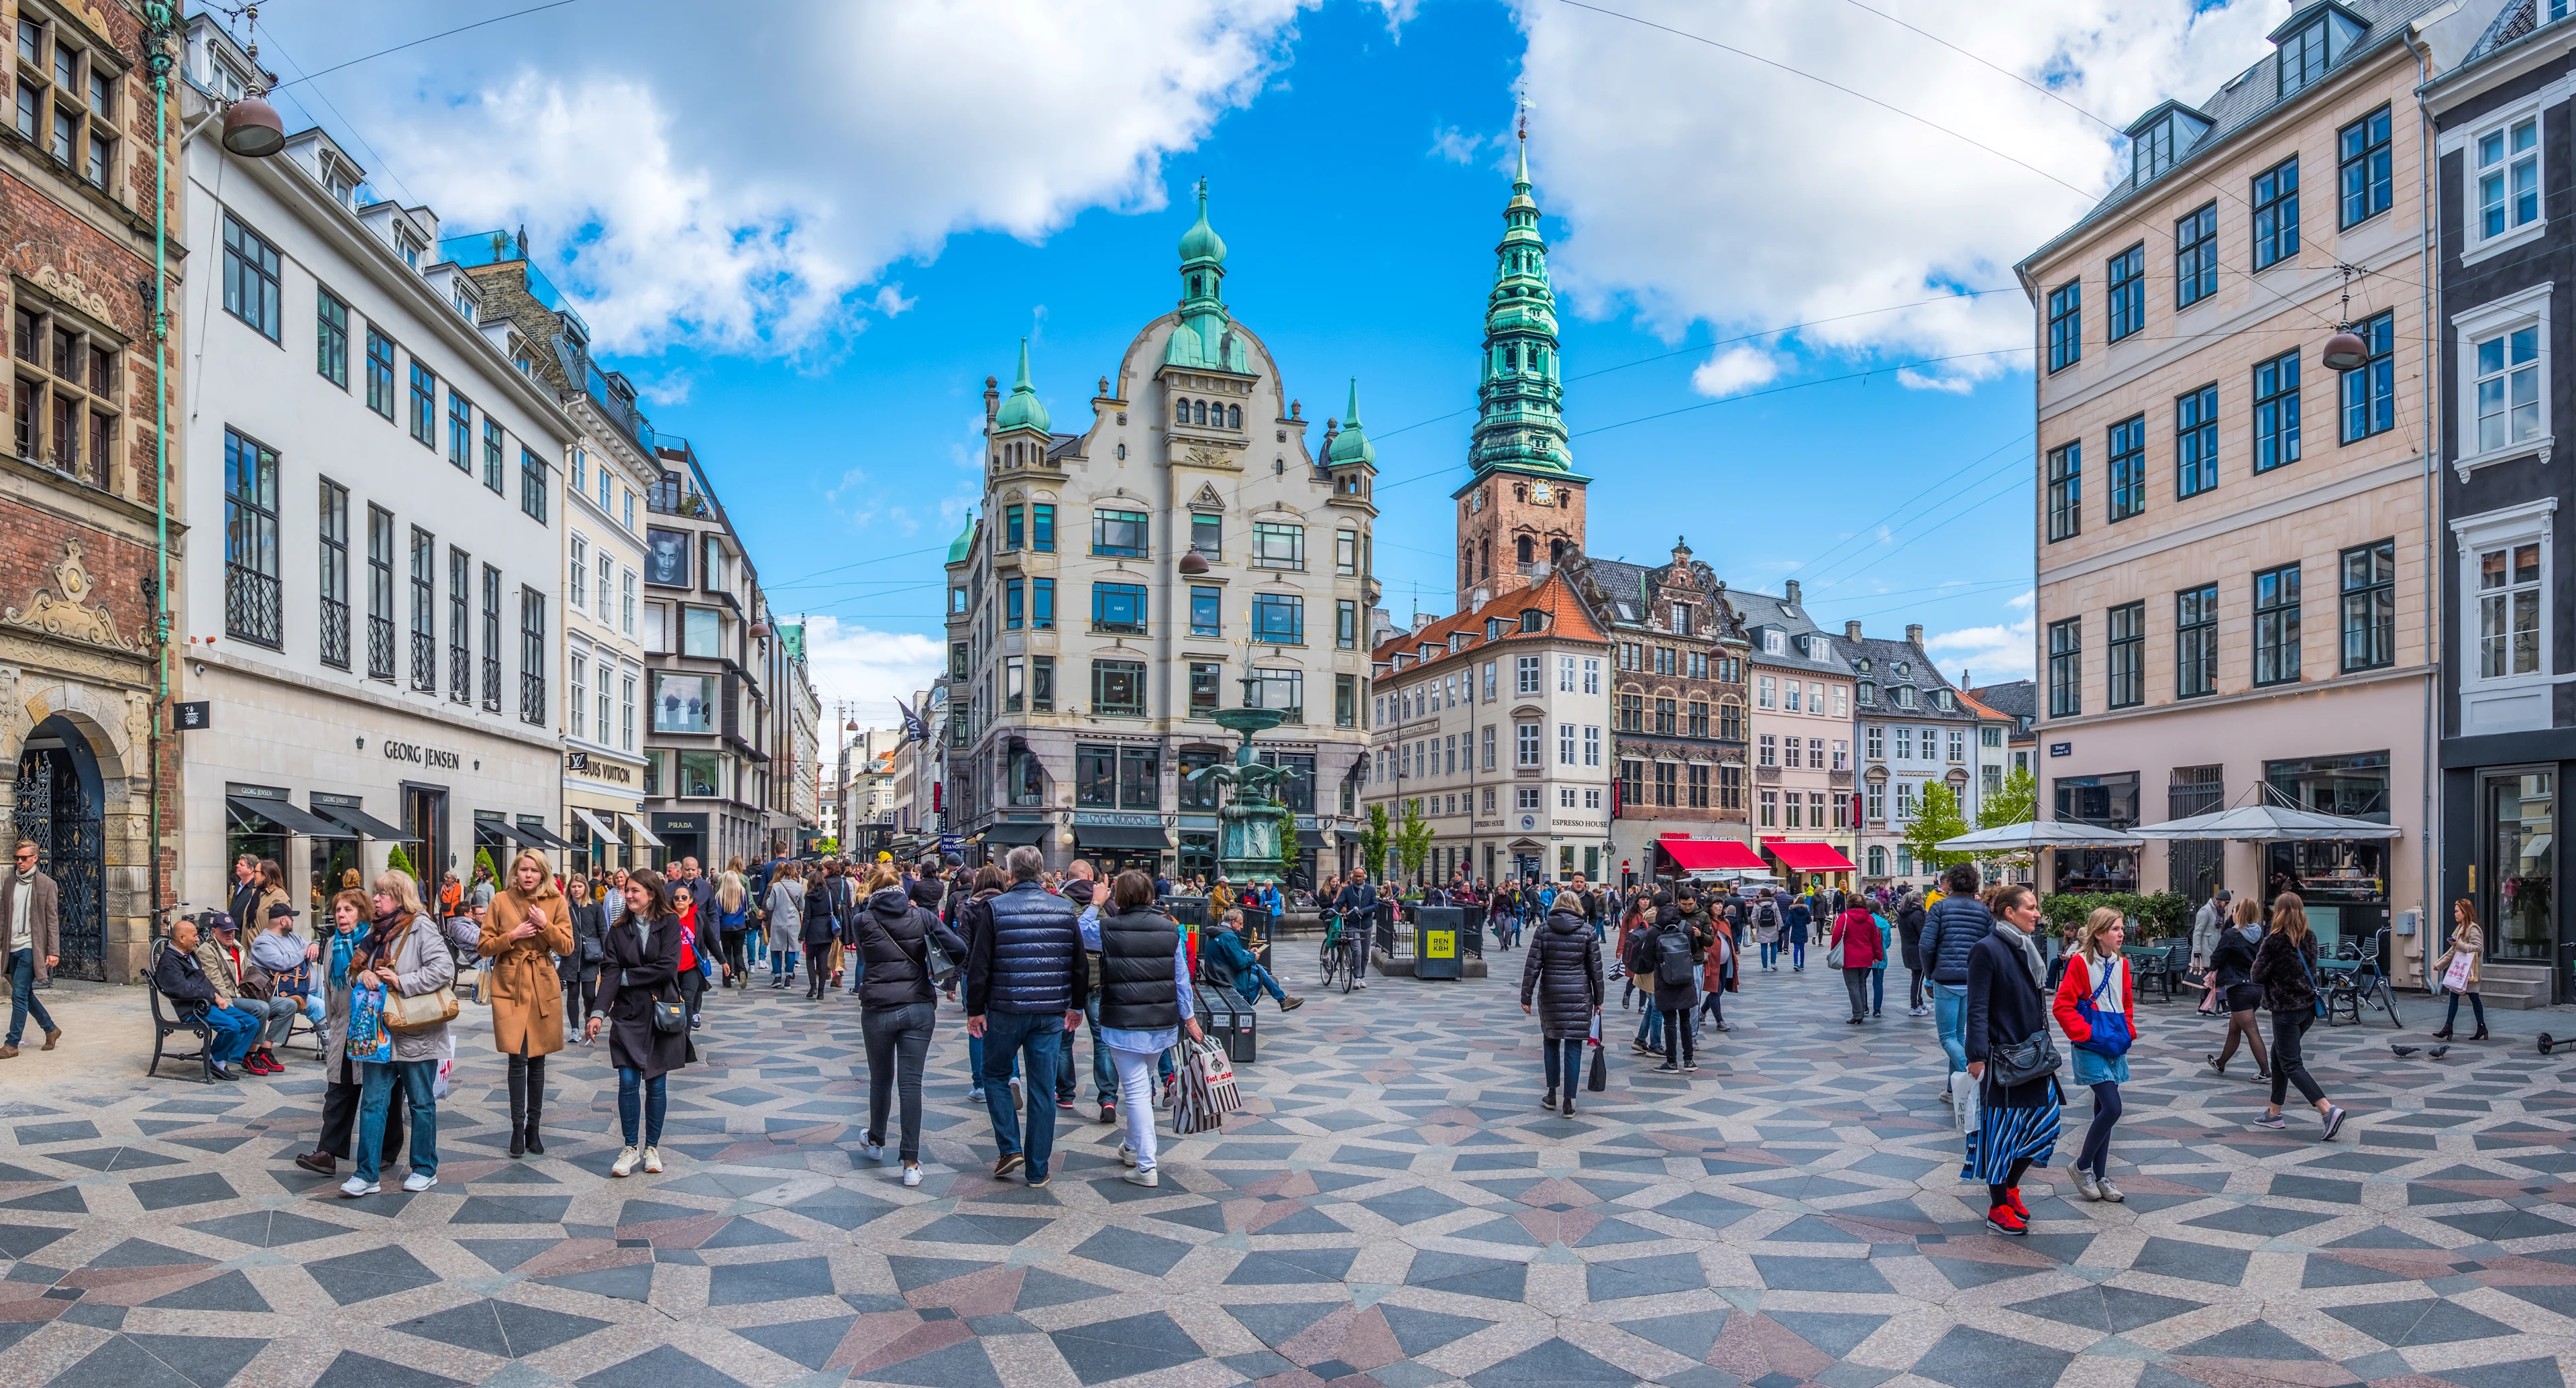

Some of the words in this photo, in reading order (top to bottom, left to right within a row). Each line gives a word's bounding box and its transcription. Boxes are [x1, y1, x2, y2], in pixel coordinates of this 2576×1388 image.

[70, 572, 79, 590] 6
[906, 716, 921, 741] HAY
[384, 740, 421, 763] GEORG
[425, 747, 460, 769] JENSEN
[580, 759, 601, 778] OUIS
[602, 763, 630, 784] VUITTON
[241, 787, 257, 796] GEORG
[257, 788, 272, 796] JENSEN
[1114, 814, 1146, 825] NORDEN
[1205, 1075, 1218, 1083] Foot
